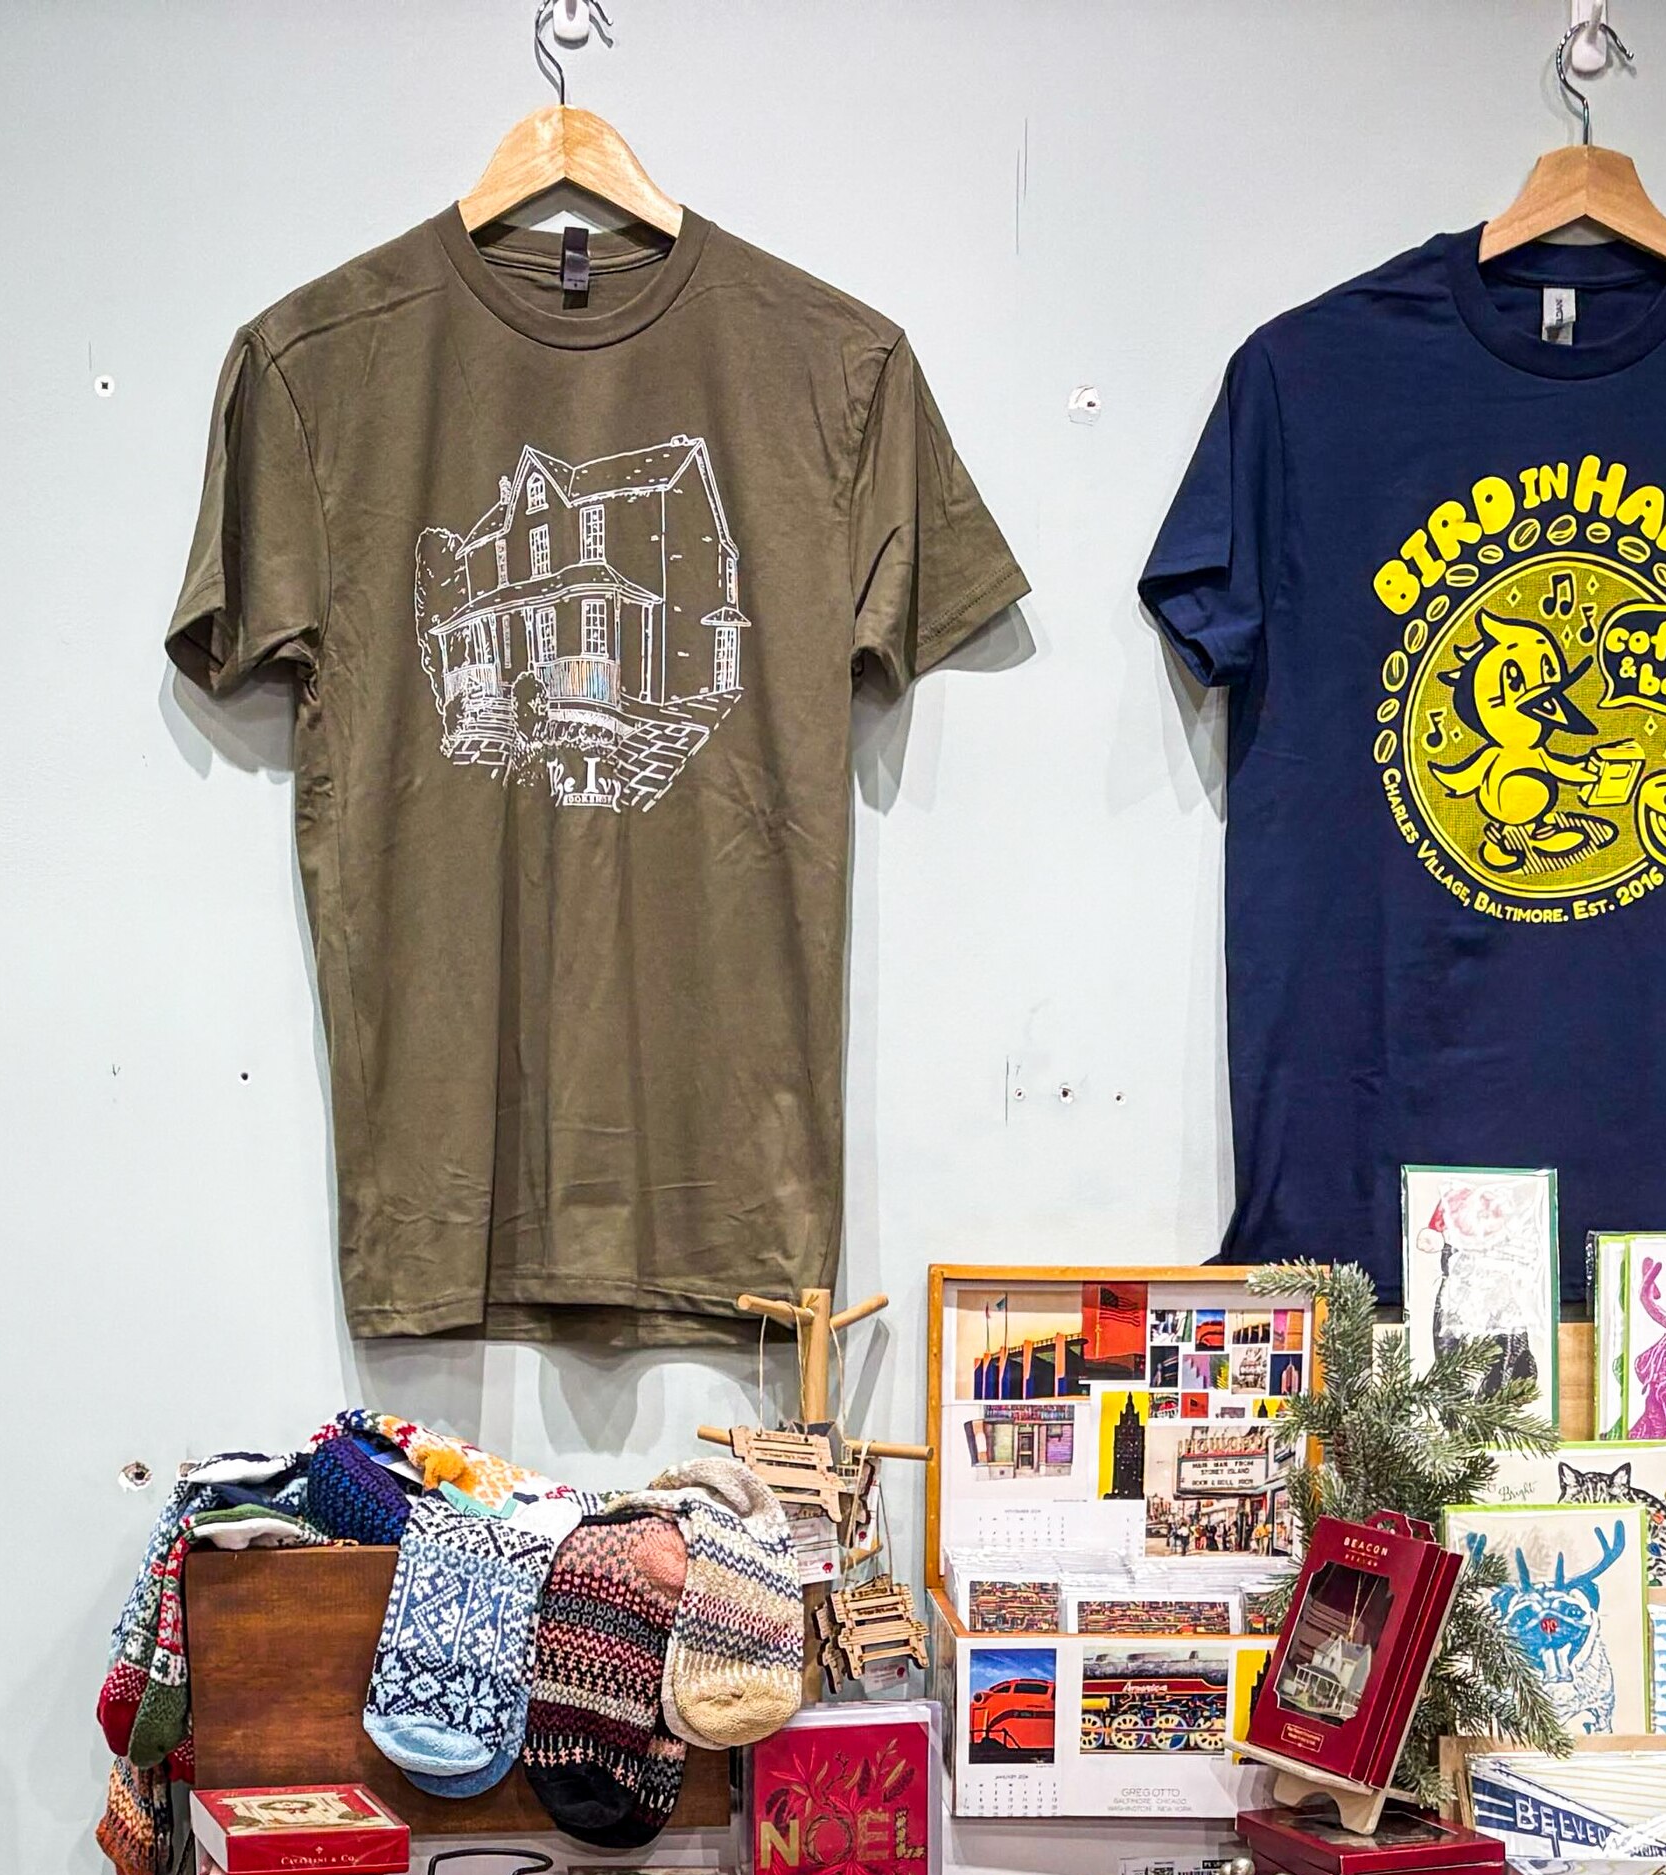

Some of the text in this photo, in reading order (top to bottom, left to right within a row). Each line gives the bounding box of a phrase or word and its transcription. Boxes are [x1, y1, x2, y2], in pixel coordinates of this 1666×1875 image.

[1373, 476, 1516, 615] BIRD
[1519, 463, 1569, 508] IN
[1619, 656, 1637, 678] &
[547, 757, 621, 813] The Ivy
[1344, 1537, 1388, 1556] BEACON
[1121, 1788, 1180, 1797] GREG OTTO
[759, 1807, 926, 1869] NOEL
